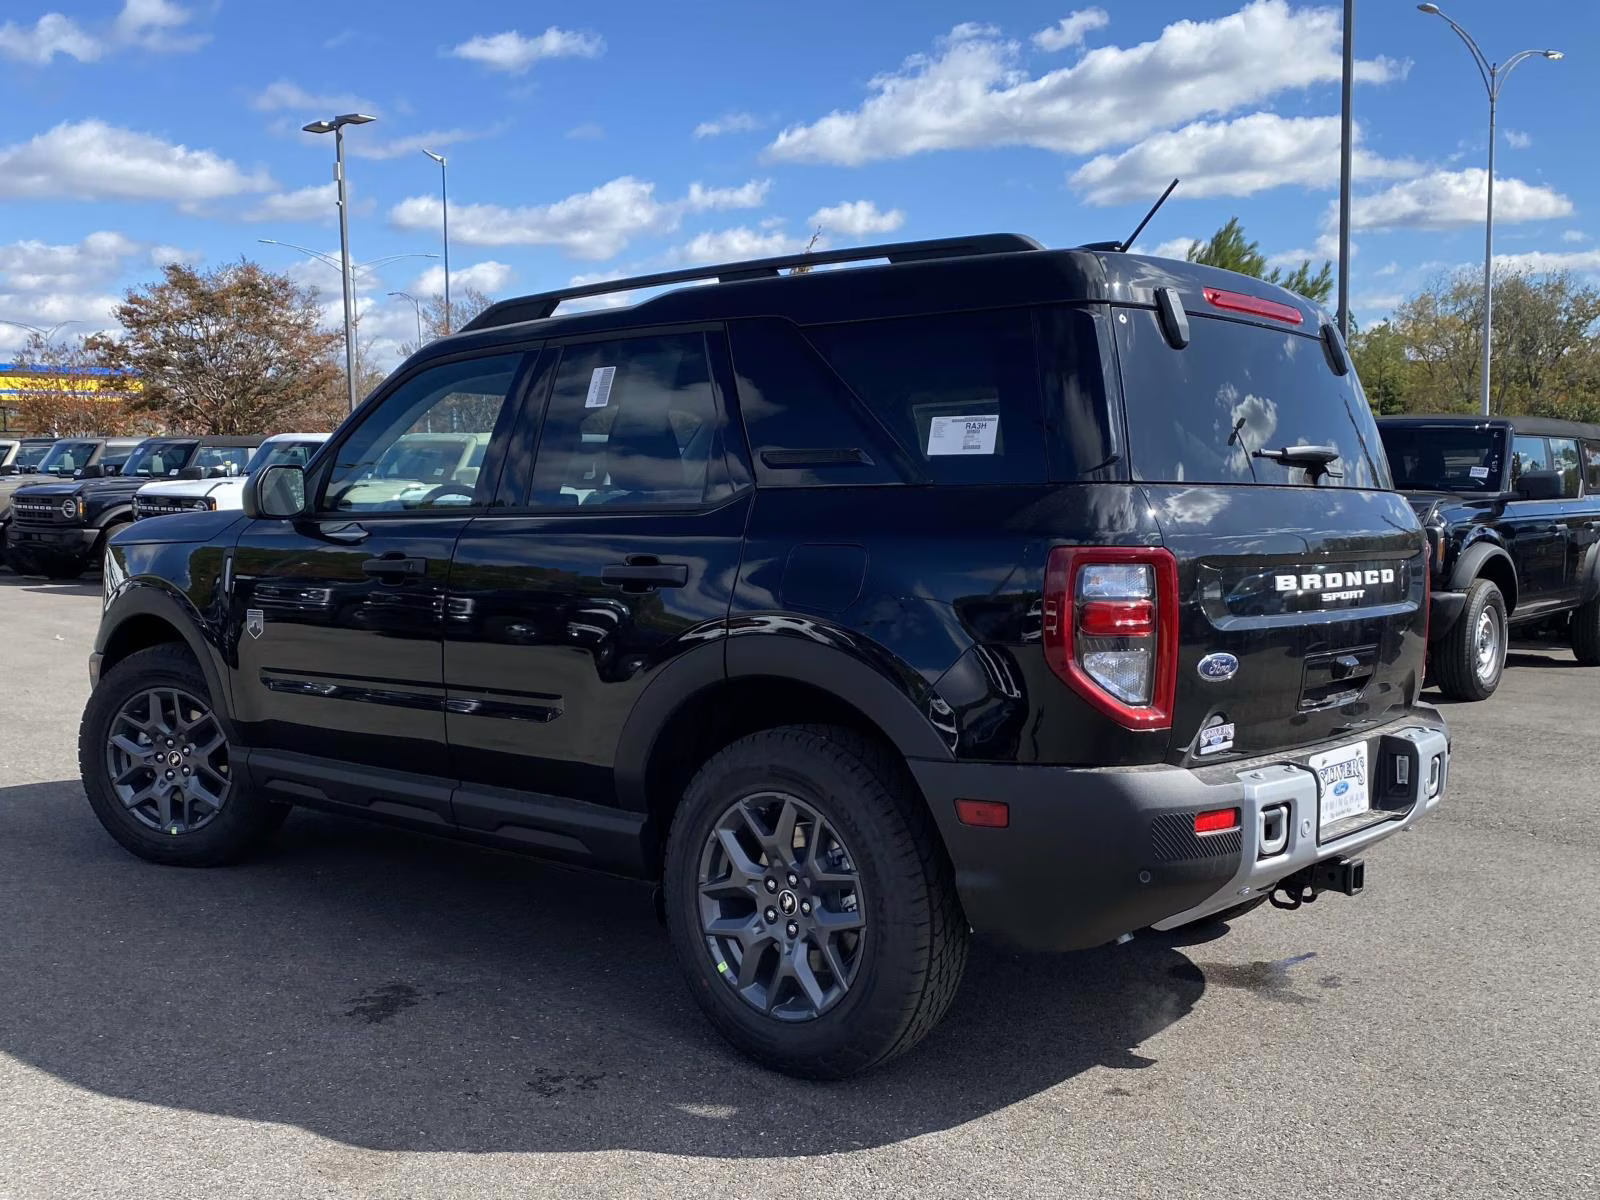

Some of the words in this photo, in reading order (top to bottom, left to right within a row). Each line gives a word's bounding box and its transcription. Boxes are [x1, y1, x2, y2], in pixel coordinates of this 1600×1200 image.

[1274, 568, 1394, 591] BRONCO
[1321, 590, 1365, 602] SPORT
[1207, 657, 1232, 675] Ford
[1319, 756, 1365, 798] STIVERS
